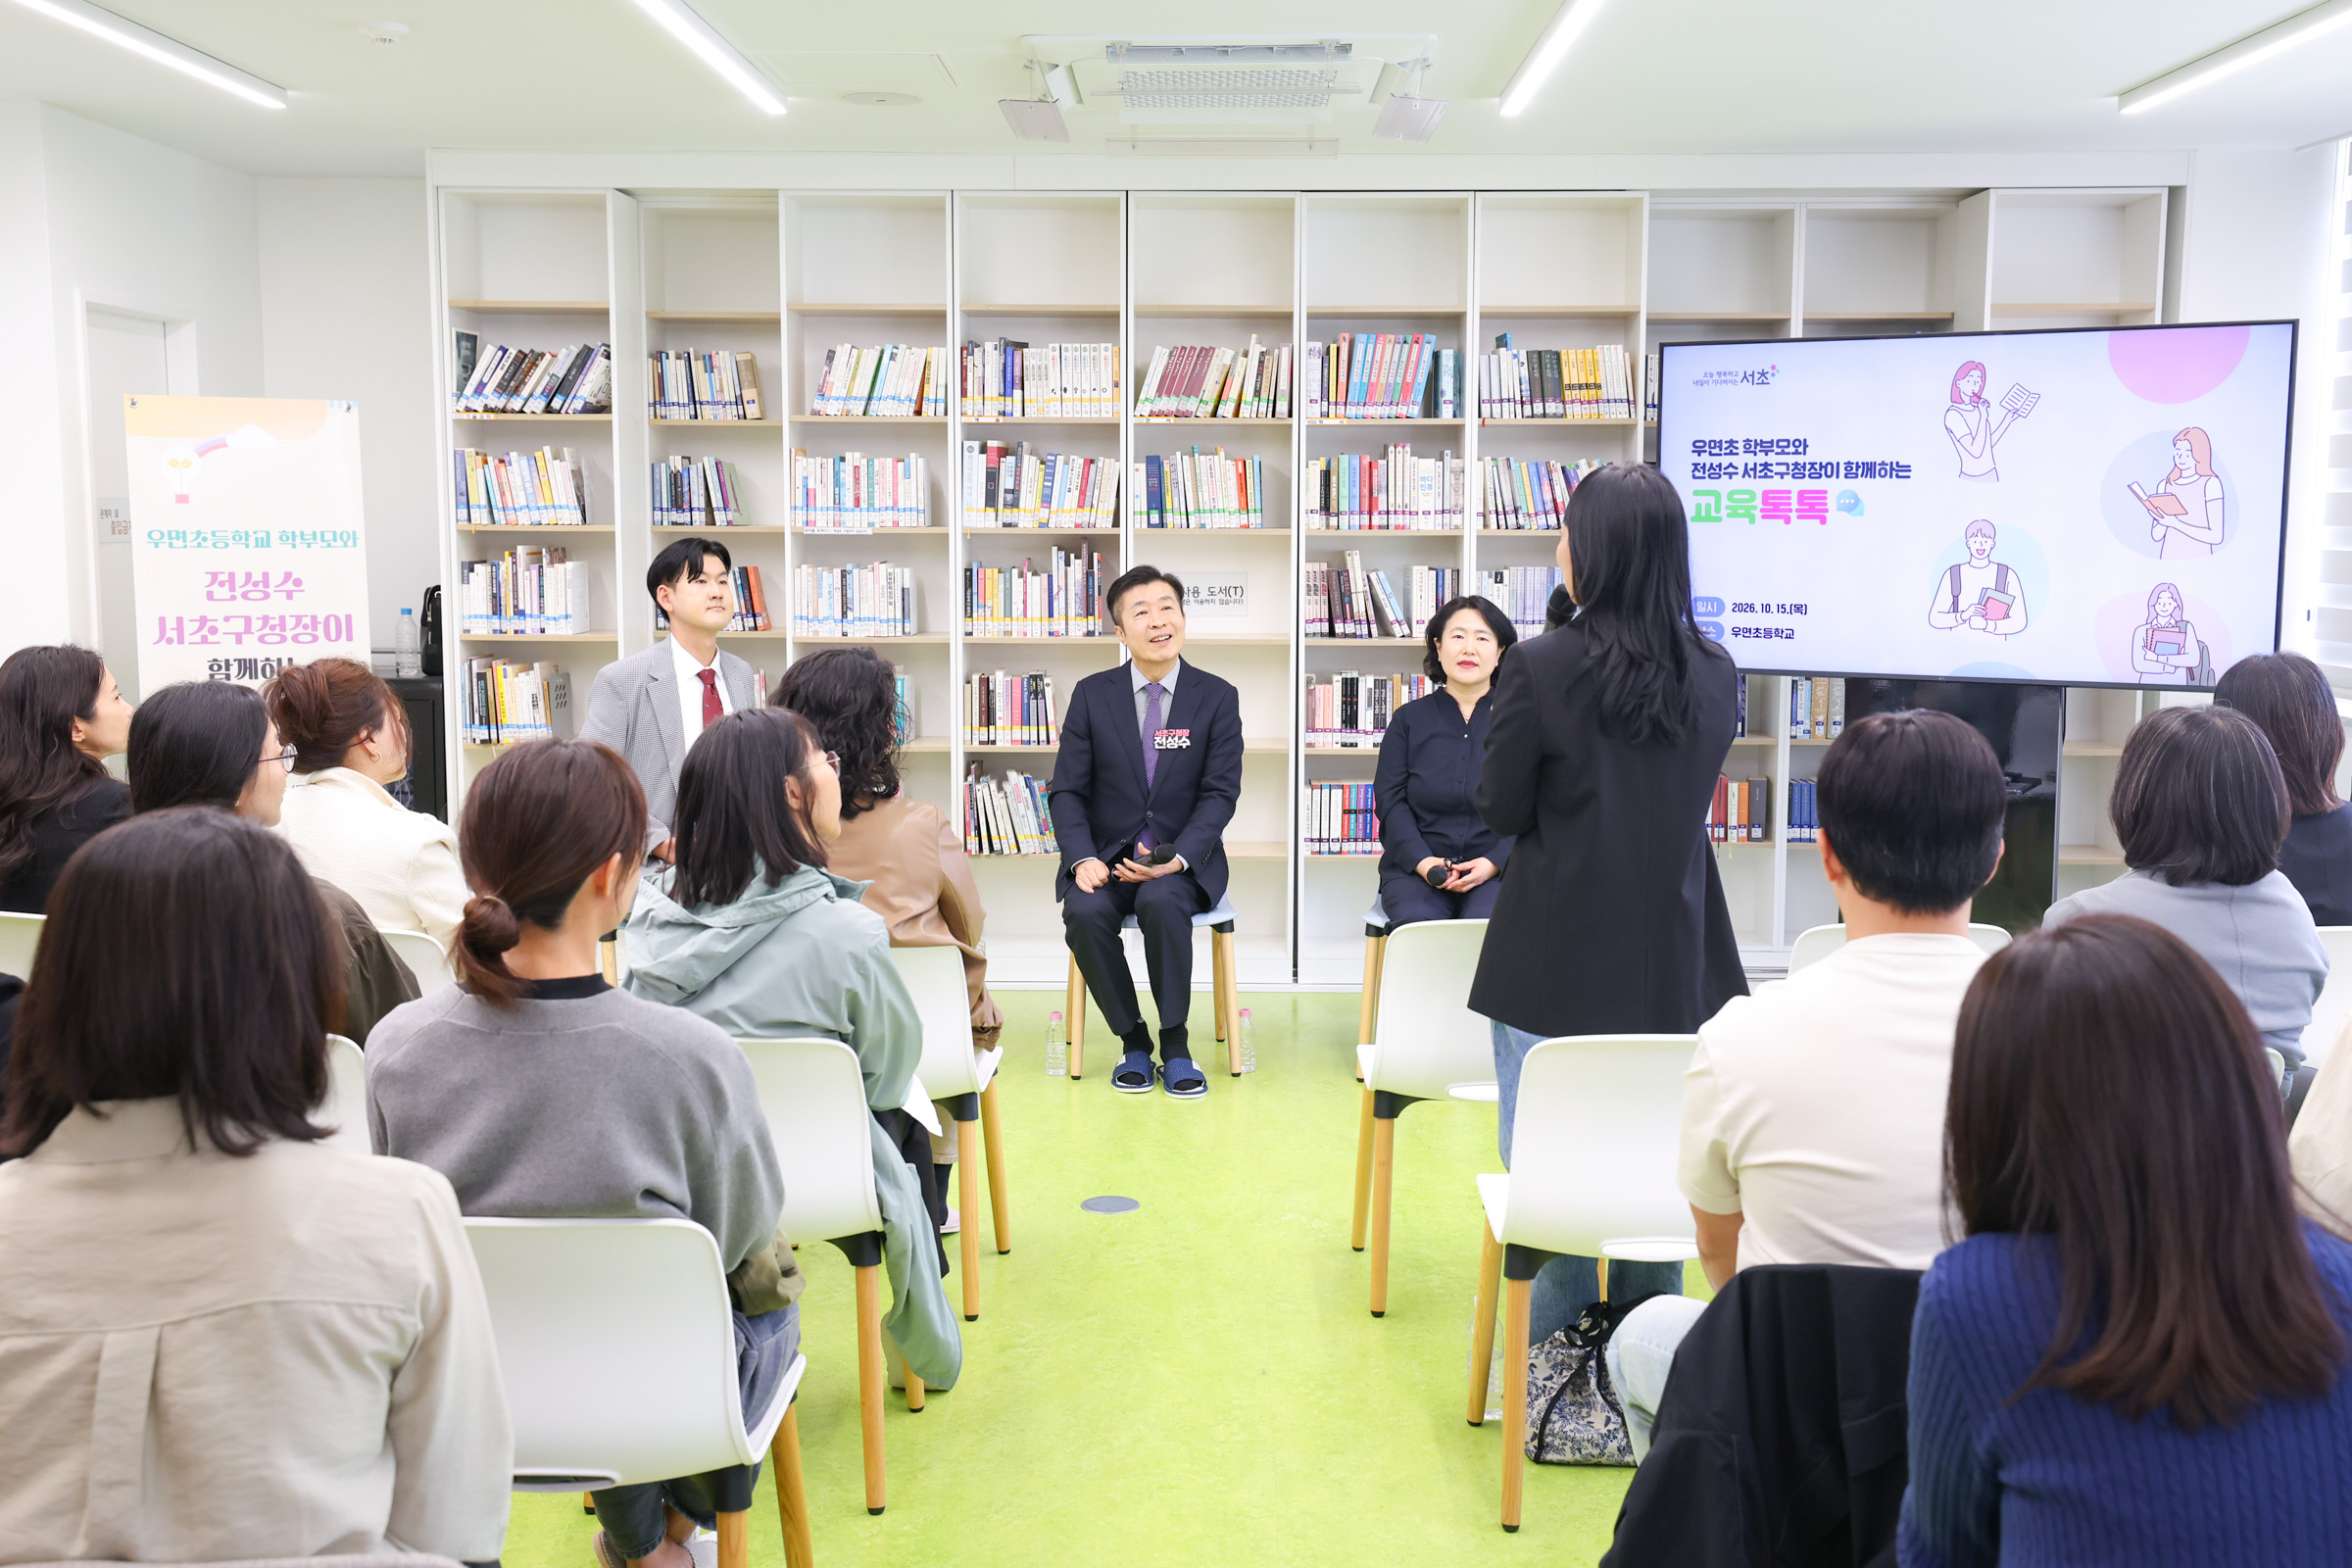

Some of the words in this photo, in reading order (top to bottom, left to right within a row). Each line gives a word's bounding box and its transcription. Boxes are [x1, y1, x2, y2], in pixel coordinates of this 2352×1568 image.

[1692, 378, 1710, 387] 내일이
[1740, 368, 1771, 386] 서초
[1690, 438, 1740, 457] 우면초
[1741, 438, 1809, 457] 학부모와
[1690, 461, 1740, 480] 전성수
[1741, 461, 1840, 480] 서초구청장이
[1842, 460, 1912, 480] 함께하는
[1420, 483, 1434, 492] 인류
[100, 509, 113, 519] 관계자
[114, 509, 120, 518] 외
[1690, 489, 1830, 525] 교육톡톡
[146, 529, 271, 550] 우면초등학교
[278, 529, 360, 549] 학부모와
[204, 571, 306, 602] 전성수
[1206, 585, 1245, 598] 도서(T)
[1696, 601, 1717, 612] 일시
[1732, 602, 1758, 613] 2026.
[1761, 603, 1774, 614] 10.
[1777, 603, 1808, 615] 15.(목)
[152, 613, 354, 646] 서초구청장이
[1731, 626, 1795, 640] 우면초등학교
[207, 658, 293, 681] 함께하
[1818, 700, 1824, 710] 1
[1153, 736, 1192, 750] 전성수
